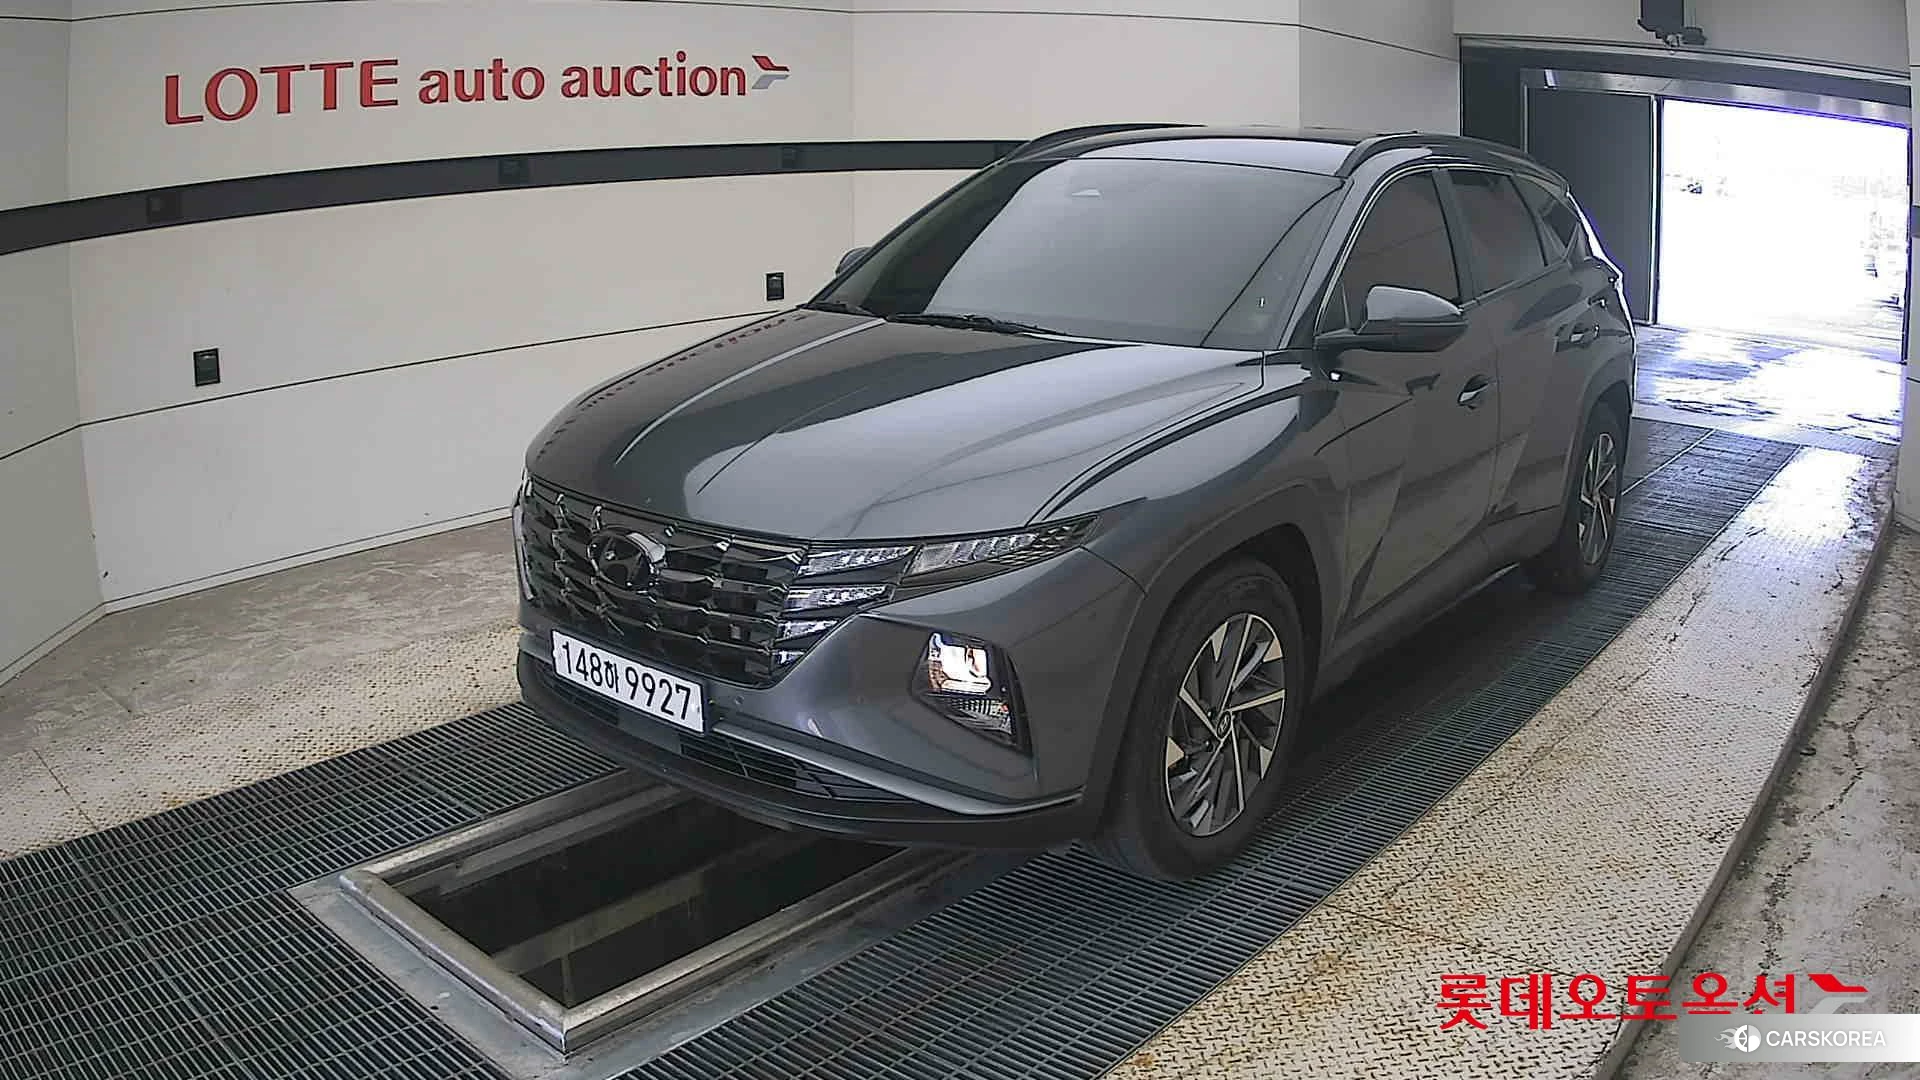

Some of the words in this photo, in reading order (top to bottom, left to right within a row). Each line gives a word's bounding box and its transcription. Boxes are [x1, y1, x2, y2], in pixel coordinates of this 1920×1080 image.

[164, 58, 400, 125] LOTTE
[418, 58, 546, 104] auto
[561, 51, 748, 98] auction
